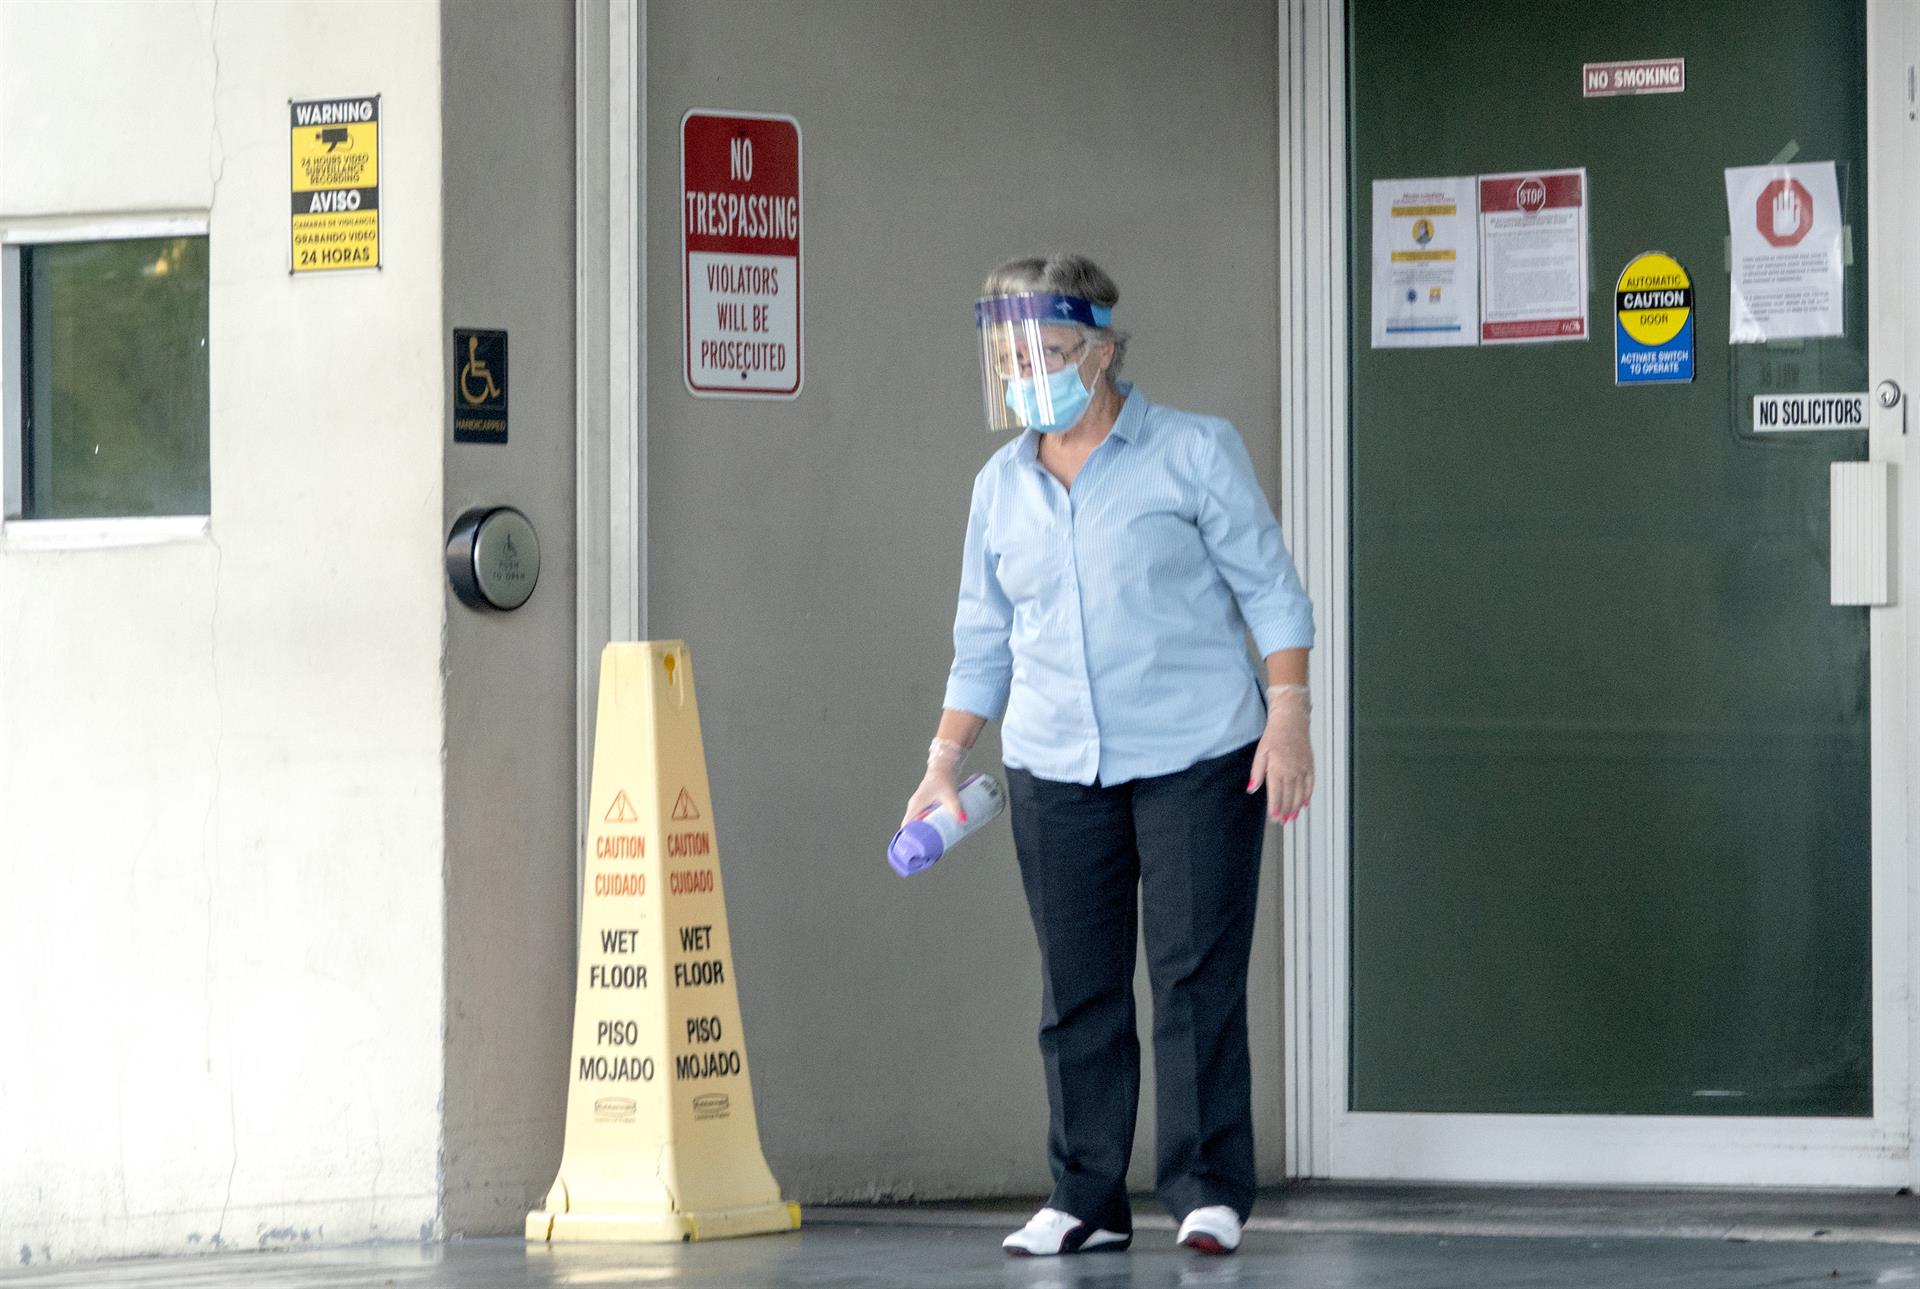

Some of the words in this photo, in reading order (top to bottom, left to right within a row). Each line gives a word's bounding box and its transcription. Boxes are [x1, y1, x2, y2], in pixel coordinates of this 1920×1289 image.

[1588, 70, 1609, 90] NO
[1614, 66, 1680, 88] SMOKING
[296, 100, 374, 125] WARNING
[305, 162, 365, 176] SURVEILLANCE
[313, 153, 342, 167] HOURS
[344, 151, 369, 164] VIDEO
[730, 137, 753, 181] NO
[310, 172, 360, 186] RECORDING
[309, 189, 361, 213] AVISO
[1520, 188, 1543, 206] STOP
[686, 191, 798, 241] TRESPASSING
[295, 231, 347, 245] GRABANDO
[349, 229, 376, 242] VIDEO
[301, 249, 317, 265] 24
[321, 246, 370, 264] HORAS
[707, 263, 779, 296] VIOLATORS
[1626, 275, 1681, 289] AUTOMATIC
[1623, 290, 1685, 310] CAUTION
[717, 302, 748, 333] WILL
[752, 303, 770, 334] BE
[1640, 313, 1669, 327] DOOR
[701, 340, 786, 372] PROSECUTED
[1621, 350, 1657, 365] ACTIVATE
[1658, 349, 1689, 363] SWITCH
[1630, 362, 1642, 375] TO
[1643, 360, 1680, 374] OPERATE
[1760, 400, 1778, 426] NO
[1782, 398, 1863, 426] SOLICITORS
[455, 418, 507, 432] HANDICAPPED
[596, 835, 645, 860] CAUTION
[667, 832, 710, 858] CAUTION
[594, 873, 646, 897] CUIDADO
[670, 869, 714, 895] CUIDADO
[601, 928, 639, 954] WET
[680, 925, 712, 951] WET
[590, 965, 648, 989] FLOOR
[674, 960, 725, 988] FLOOR
[598, 1020, 638, 1046] PISO
[687, 1015, 722, 1044] PISO
[579, 1056, 655, 1083] MOJADO
[676, 1050, 741, 1081] MOJADO
